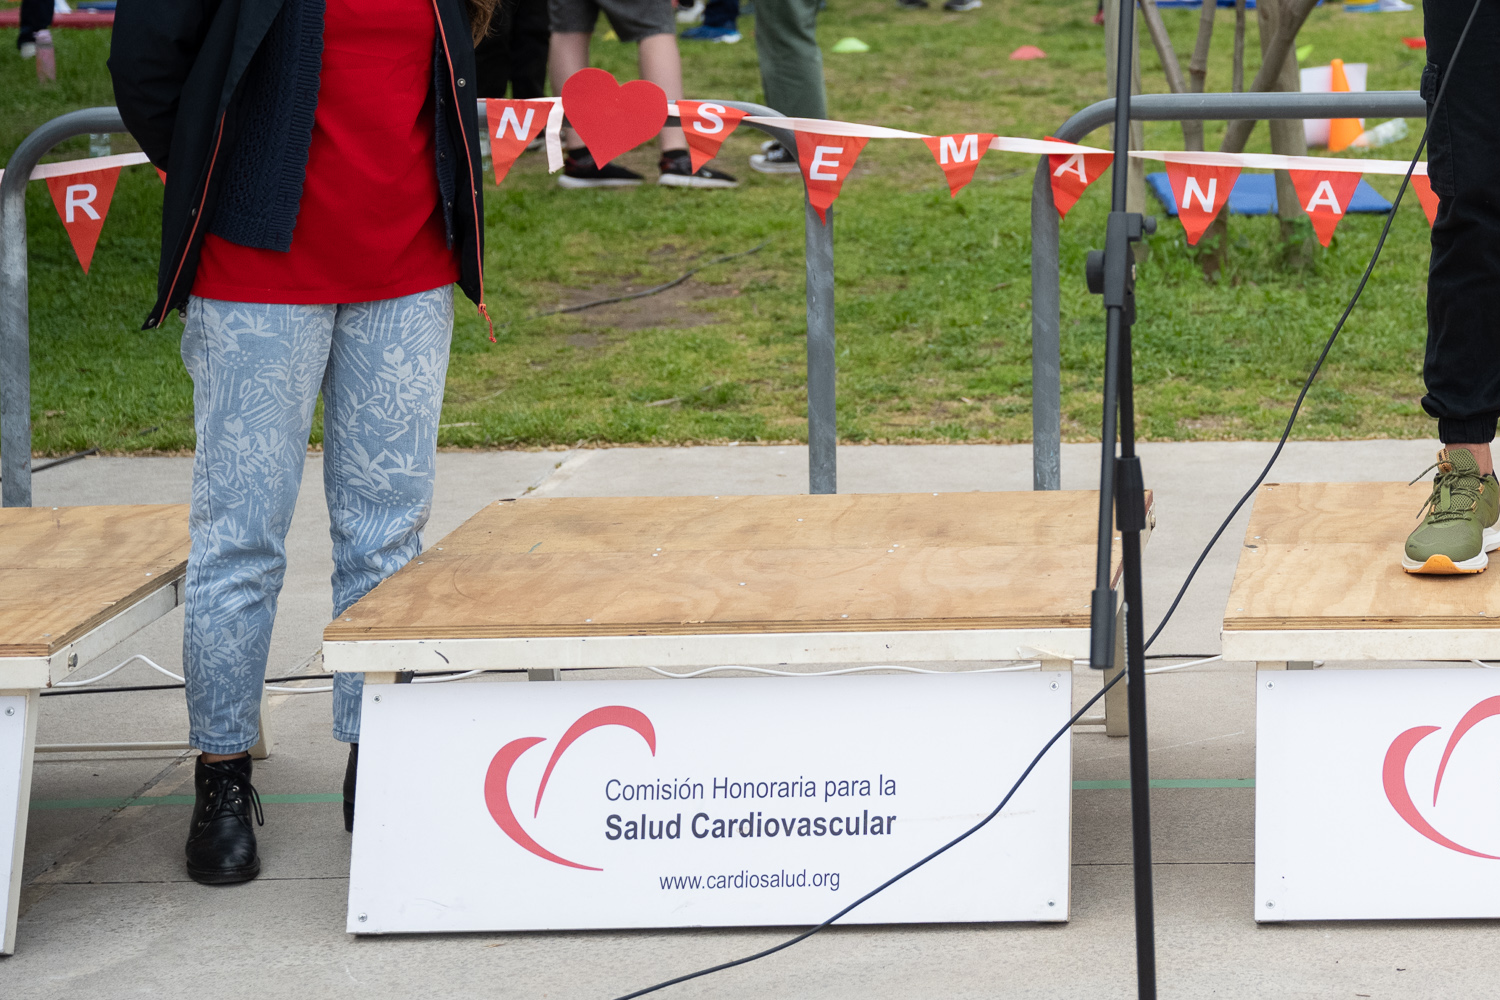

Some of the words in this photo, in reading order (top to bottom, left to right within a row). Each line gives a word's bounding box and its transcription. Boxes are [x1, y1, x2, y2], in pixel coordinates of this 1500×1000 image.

[606, 778, 703, 801] Comisión
[713, 777, 816, 799] Honoraria
[825, 780, 870, 802] para
[880, 774, 896, 796] la
[605, 813, 681, 840] Salud
[692, 810, 896, 839] Cardiovascular
[660, 869, 839, 891] www.cardiosalud.org
